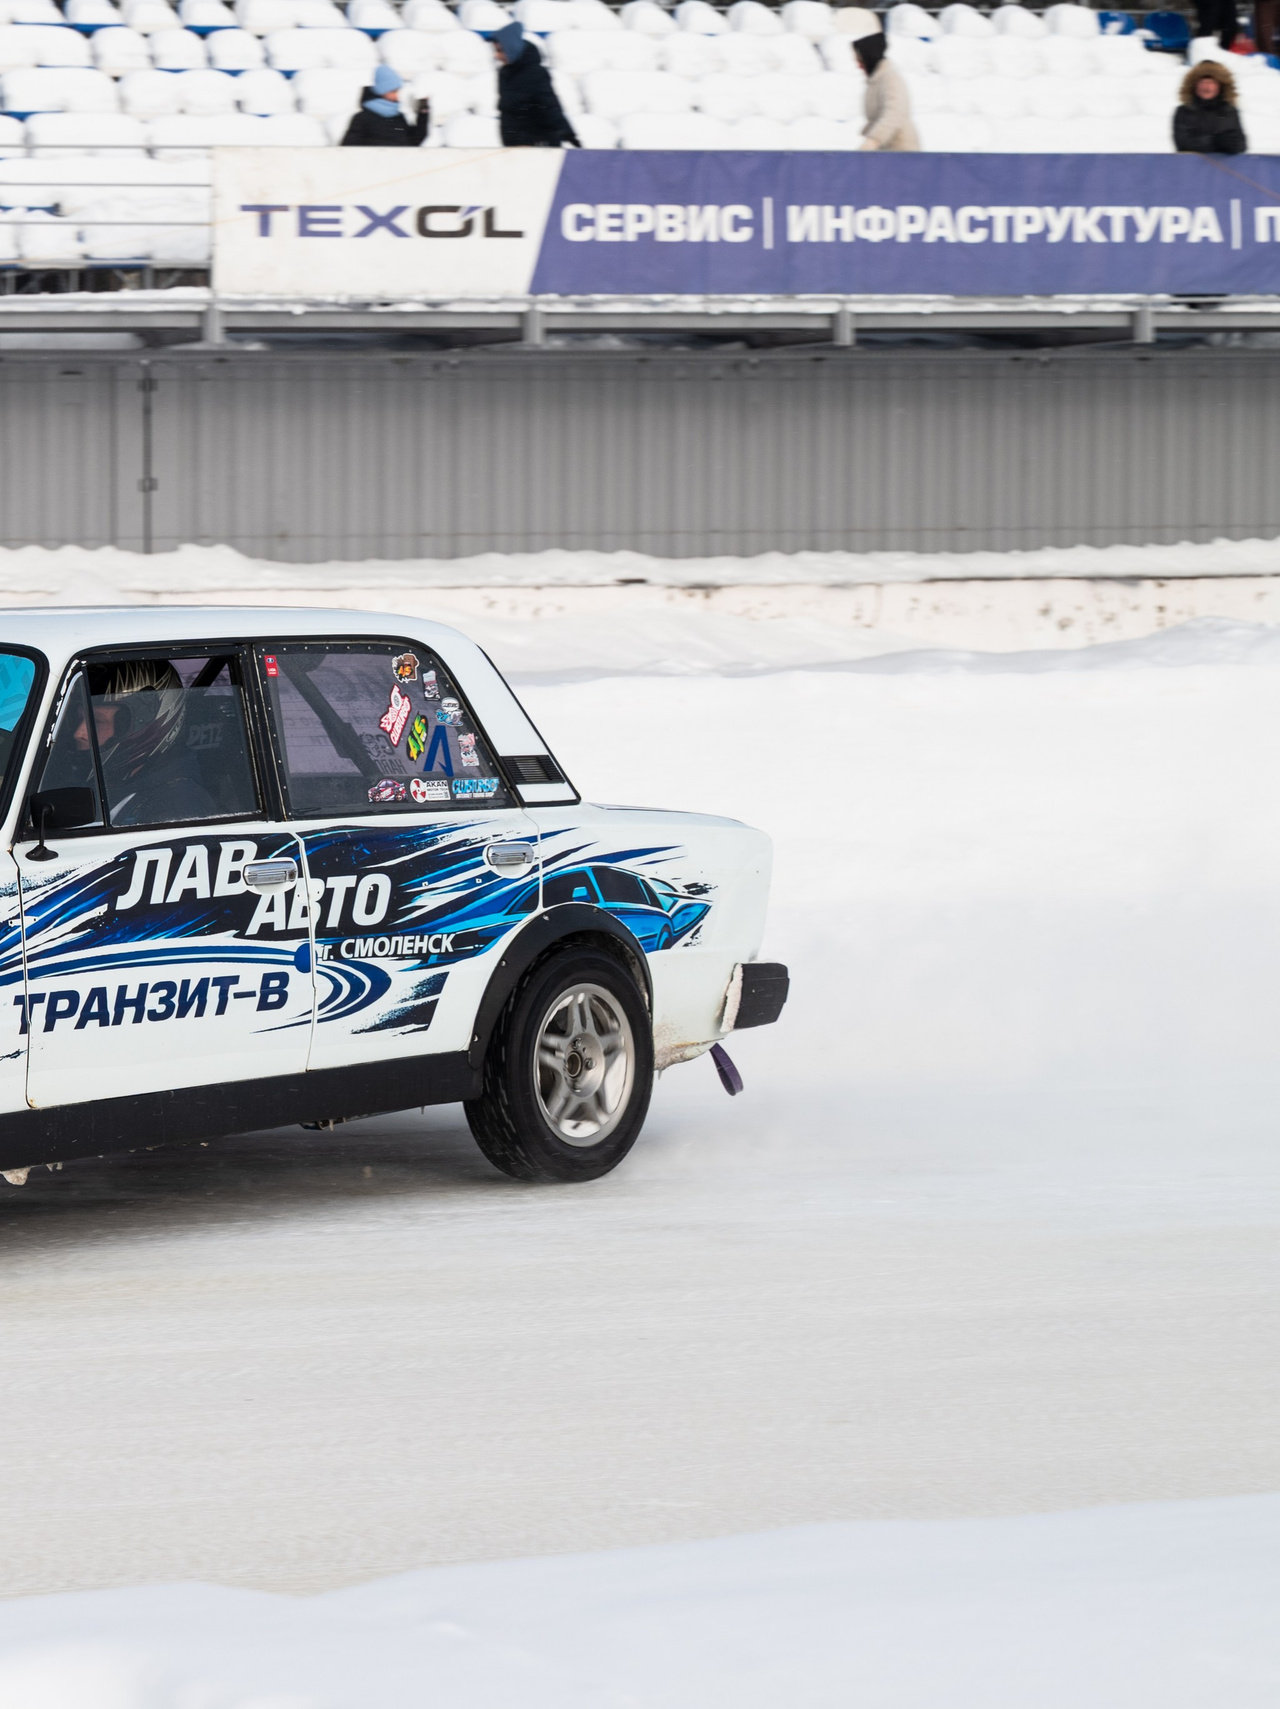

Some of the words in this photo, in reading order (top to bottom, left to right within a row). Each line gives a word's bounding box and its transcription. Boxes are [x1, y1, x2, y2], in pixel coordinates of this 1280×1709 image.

[239, 205, 525, 238] TEXOL
[561, 204, 754, 242] СЕРВИС
[786, 205, 1224, 243] ИНФРАСТРУКТУРА
[426, 780, 448, 788] AKAN
[115, 840, 258, 910] ЛАВ
[245, 873, 392, 936] АВТО
[340, 933, 456, 959] СМОЛЕНСК
[13, 971, 290, 1035] ТРАНЗИТ-В
